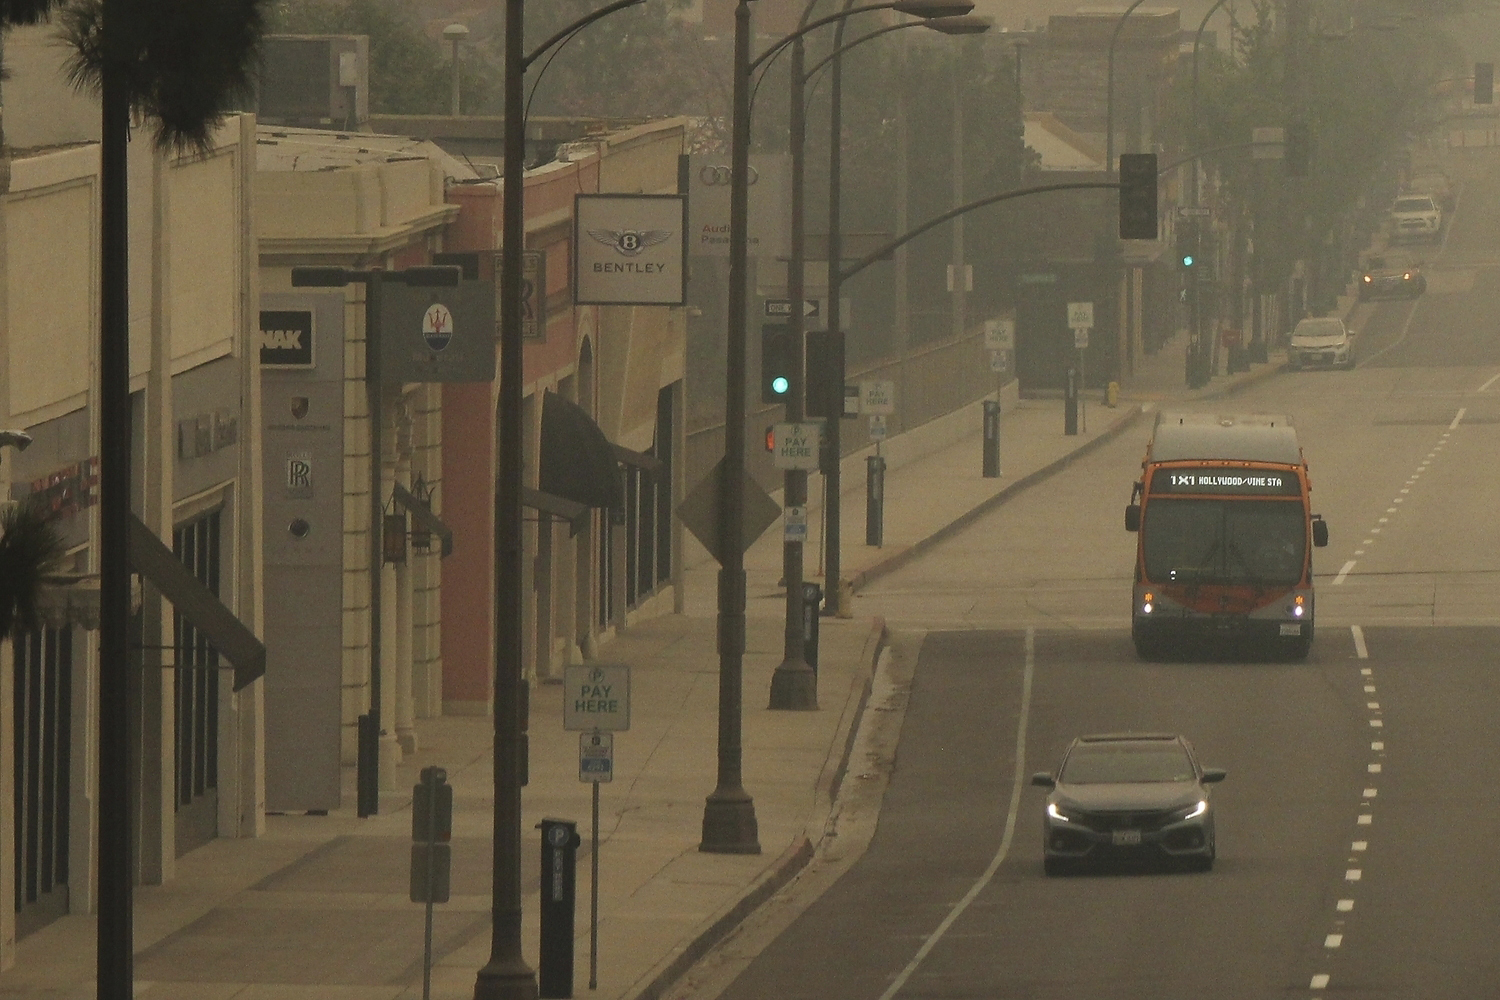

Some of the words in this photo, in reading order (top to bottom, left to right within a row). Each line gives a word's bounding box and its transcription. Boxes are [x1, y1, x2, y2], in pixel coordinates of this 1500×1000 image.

[702, 224, 730, 233] Audi
[593, 263, 665, 273] BENTLEY
[785, 438, 806, 447] PAY
[781, 447, 811, 457] HERE
[1267, 478, 1282, 487] STA
[582, 685, 612, 698] PAY
[575, 700, 618, 712] HERE
